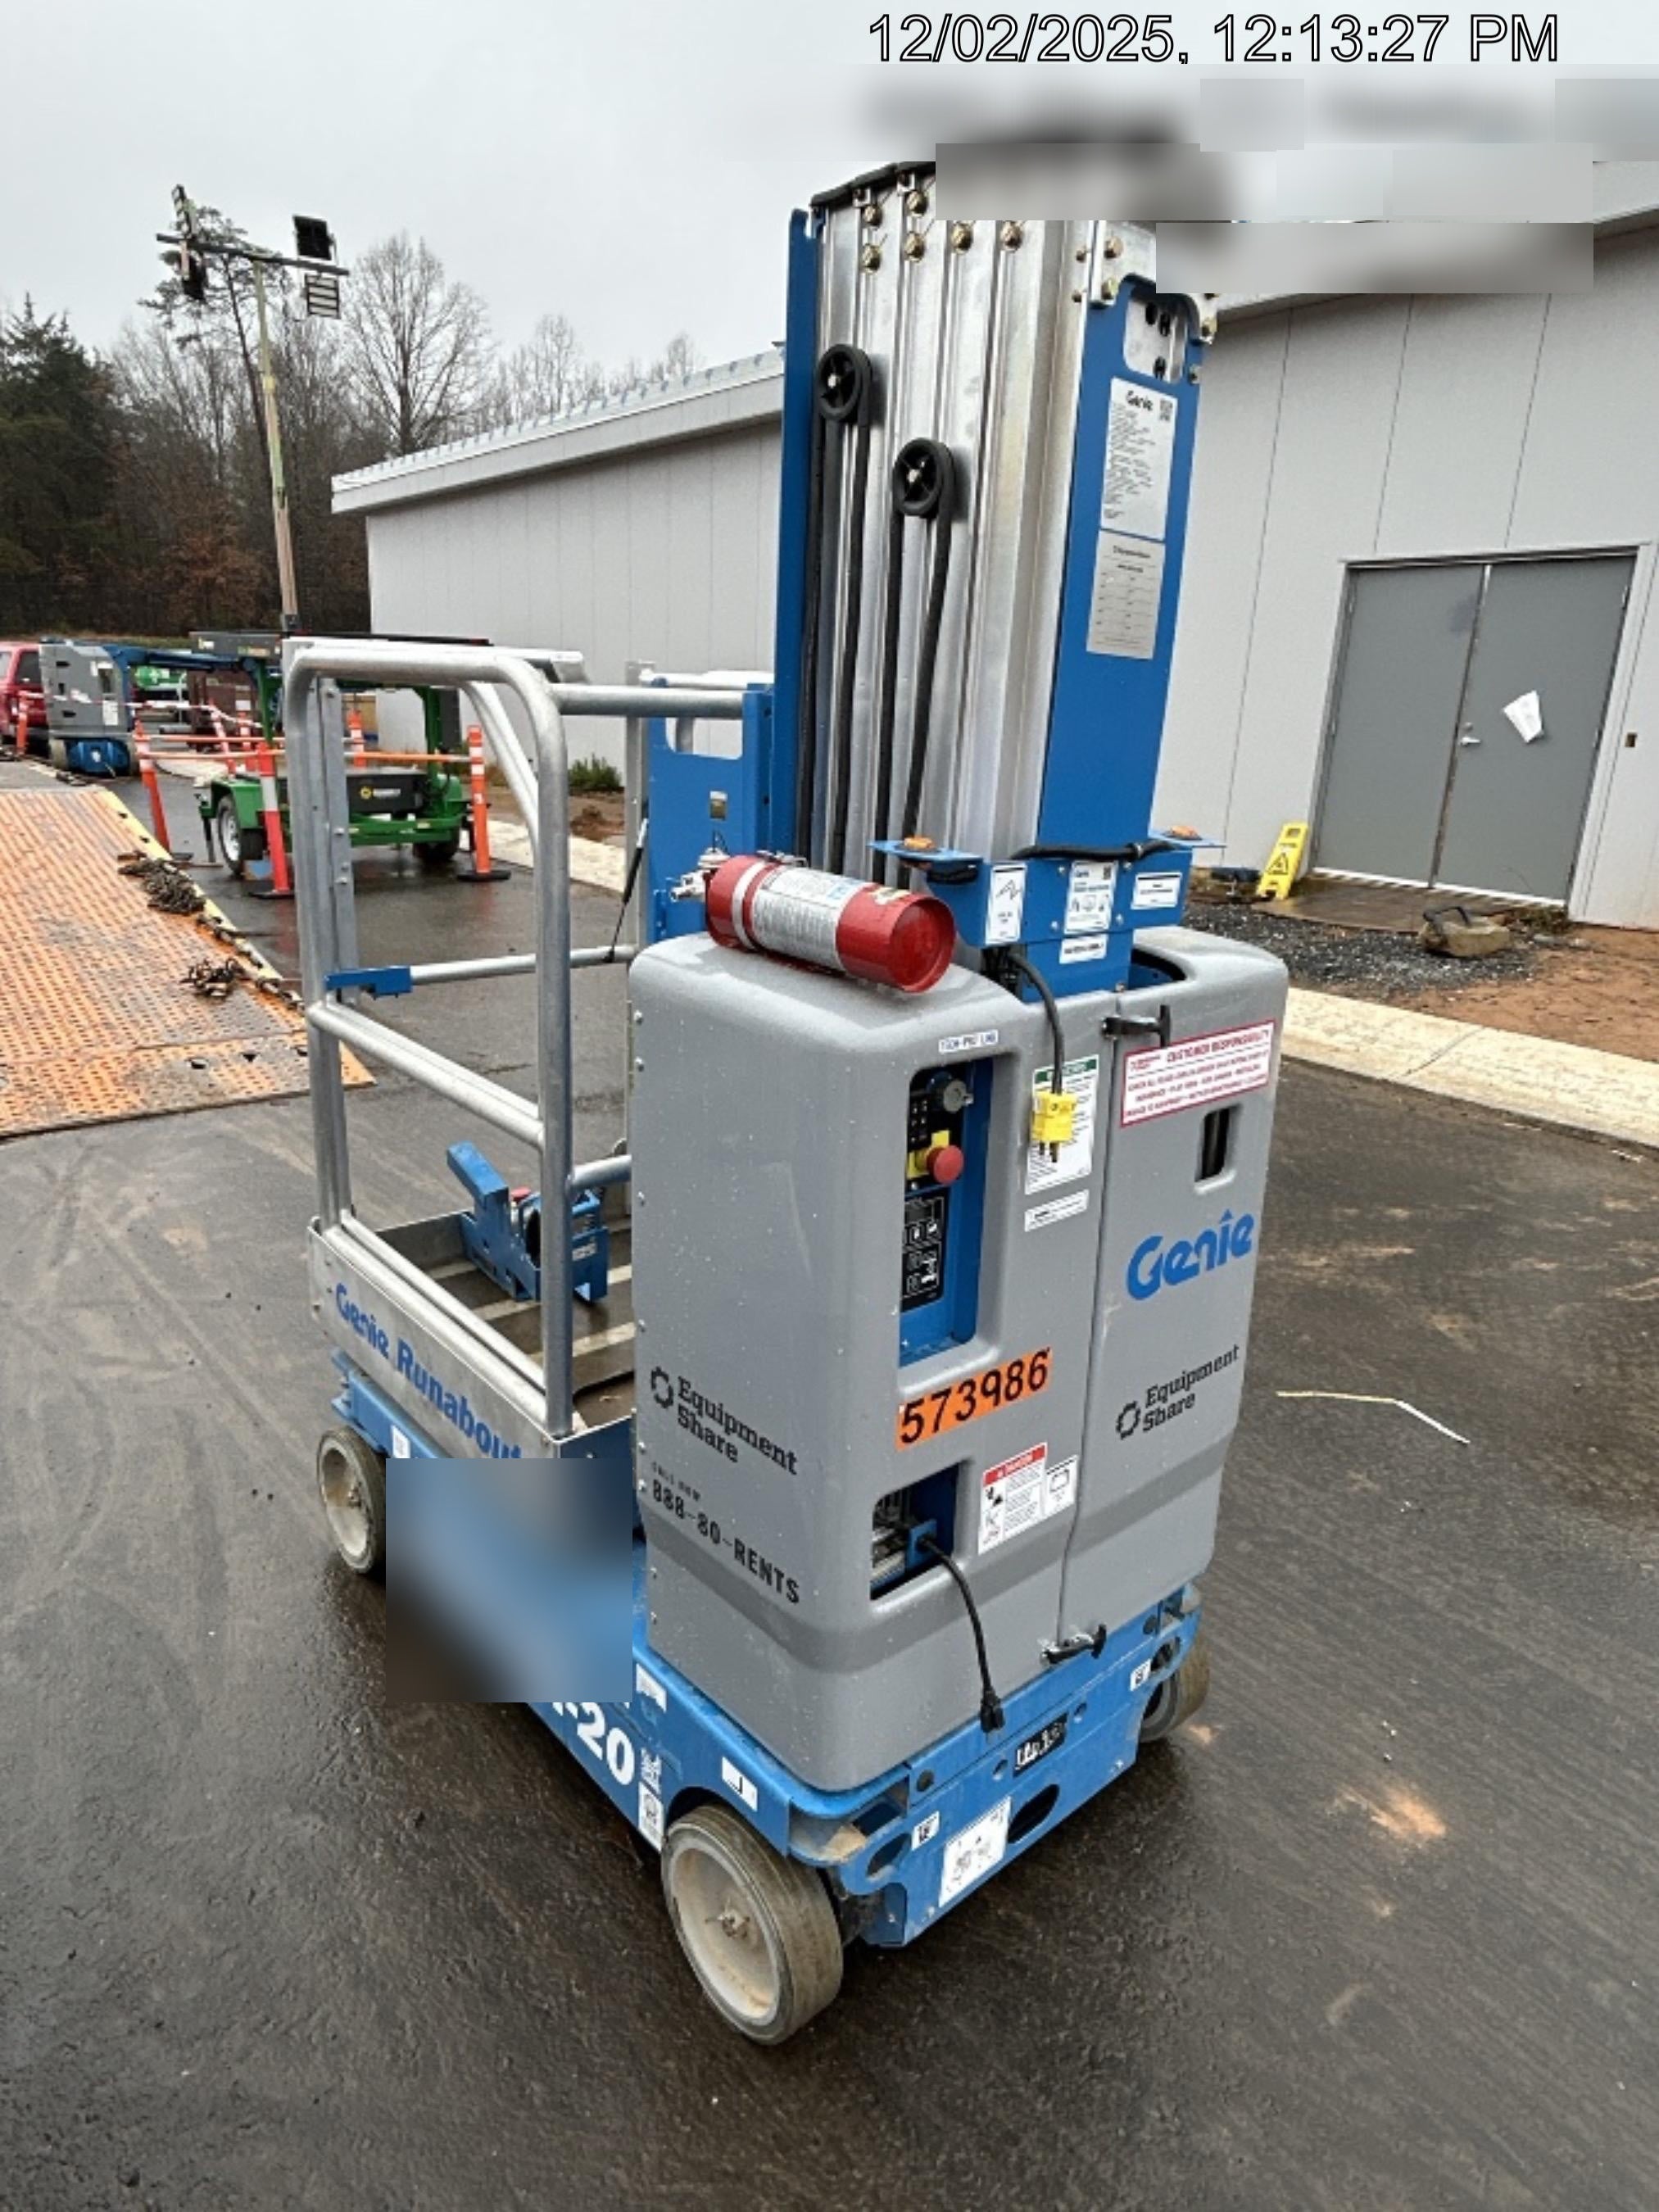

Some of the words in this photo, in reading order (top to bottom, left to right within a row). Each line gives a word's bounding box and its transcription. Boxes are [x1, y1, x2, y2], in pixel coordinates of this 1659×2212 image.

[1126, 1208, 1254, 1300] Genie
[335, 1283, 389, 1360] Genie
[901, 1347, 1050, 1444] 573986
[1143, 1392, 1195, 1432] Share
[1145, 1344, 1240, 1408] Equipment
[678, 1376, 797, 1475] Equipment
[678, 1403, 738, 1463] Share
[653, 1478, 800, 1604] 888-80-RENTS
